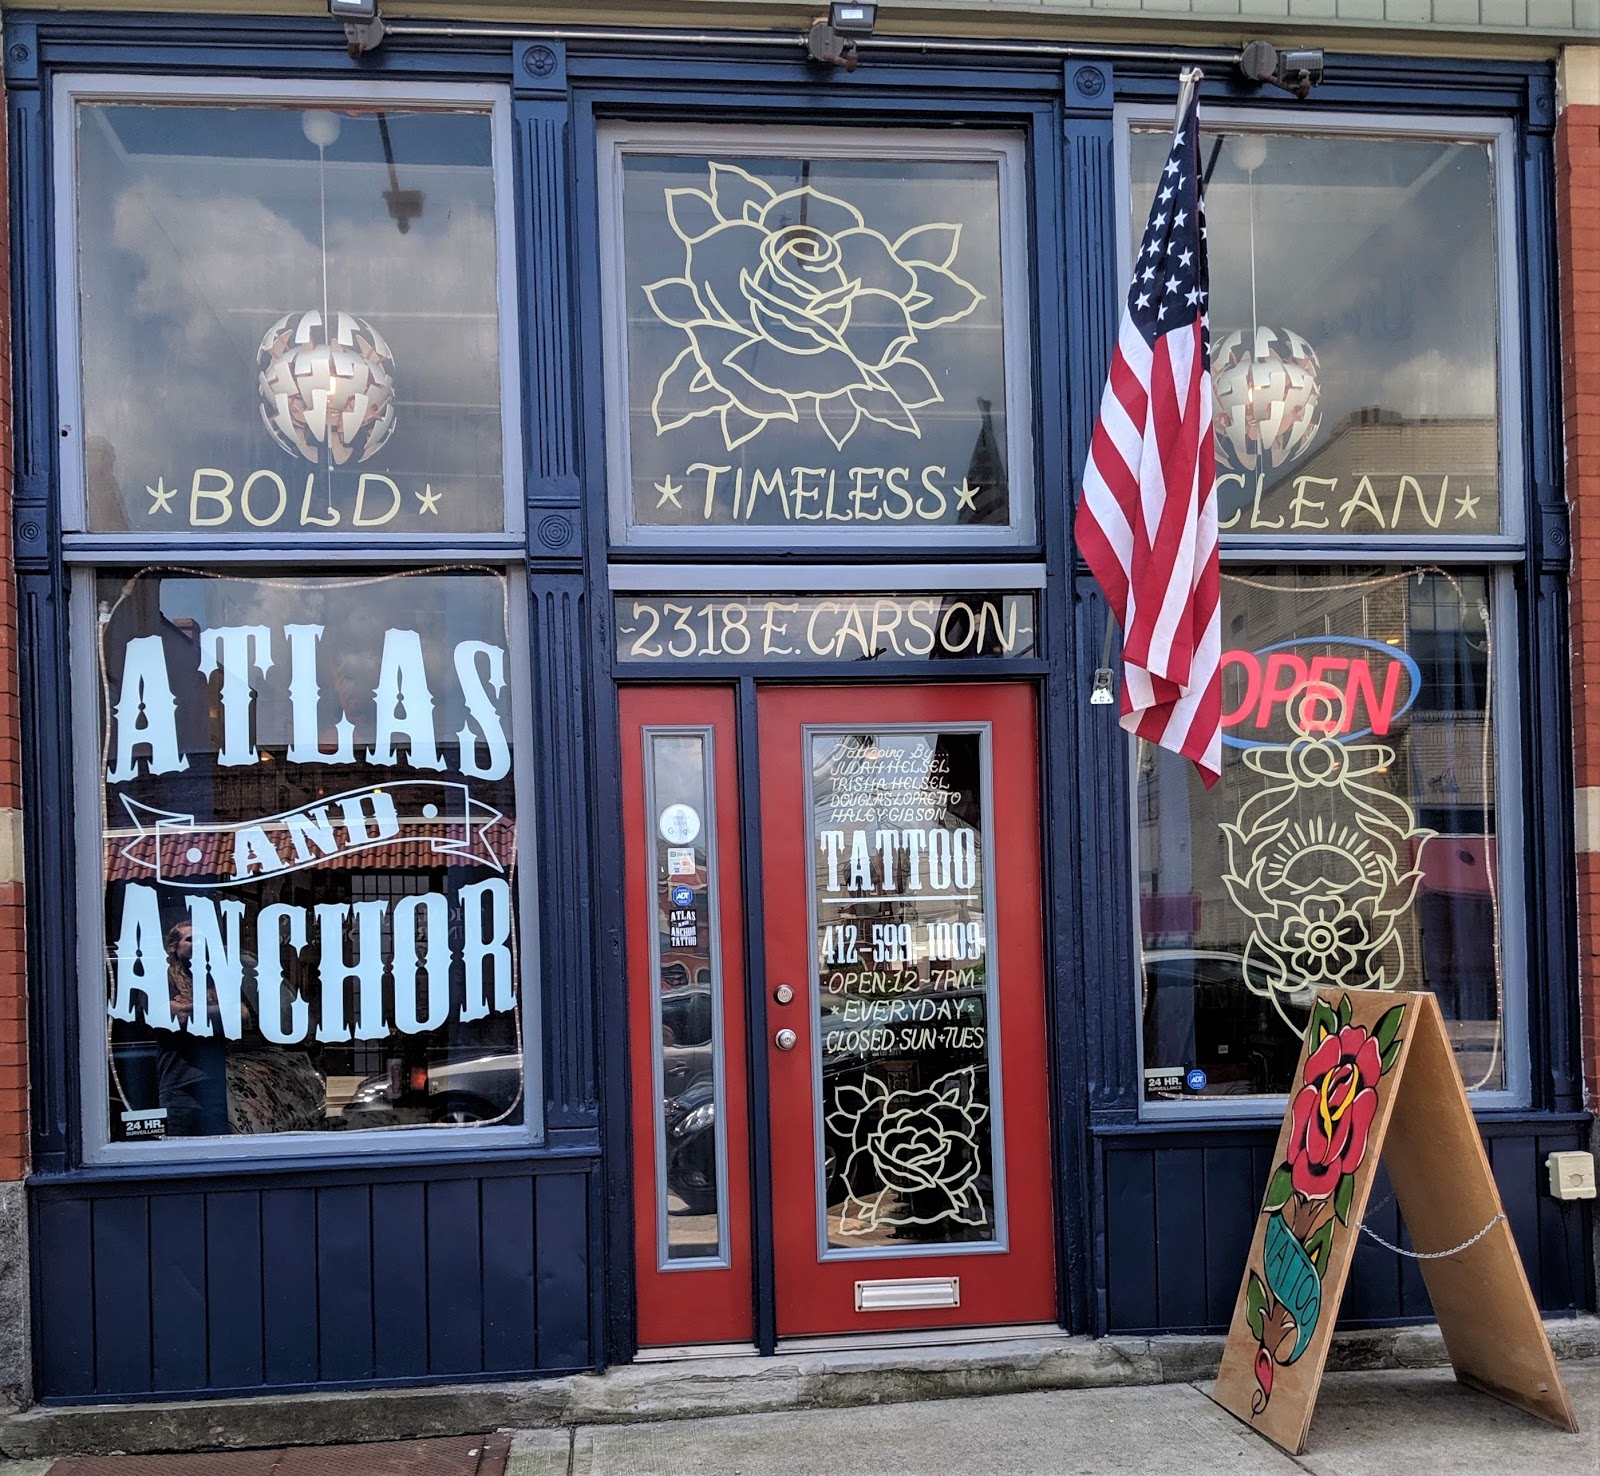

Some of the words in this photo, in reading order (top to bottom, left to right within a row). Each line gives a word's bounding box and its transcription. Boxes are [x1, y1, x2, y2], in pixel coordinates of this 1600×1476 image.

[189, 467, 401, 527] BOLD
[686, 463, 947, 521] TIMELESS
[1216, 472, 1449, 529] CLEAN
[631, 601, 751, 658] 2318
[760, 602, 801, 656] E.
[807, 600, 1017, 658] CARSON
[107, 623, 511, 784] ATLAS
[1220, 649, 1400, 736] OPEN
[832, 743, 905, 761] Tattooing
[830, 761, 885, 776] JUDAH
[887, 759, 950, 774] HELSEL
[829, 777, 888, 792] TRISHA
[891, 776, 950, 790] HELSEL
[829, 793, 893, 808] DOUGLAS
[829, 808, 887, 823] HALEY
[889, 807, 948, 821] GIBSON
[230, 791, 399, 881] AND
[820, 828, 976, 892] TATTOO
[676, 892, 690, 900] ADT
[671, 910, 696, 922] ATLAS
[671, 926, 696, 937] ANCHOR
[671, 936, 697, 947] TATTOO
[821, 922, 981, 964] 412-599-1009
[107, 877, 517, 1044] ANCHOR
[828, 971, 886, 994] OPEN
[843, 998, 966, 1023] EVERYDAY
[826, 1030, 896, 1054] CLOSED
[1148, 1078, 1161, 1086] 24
[1164, 1077, 1182, 1085] HR.
[126, 1121, 141, 1131] 24
[144, 1120, 165, 1129] HR.
[1265, 1220, 1318, 1327] TATTOO
